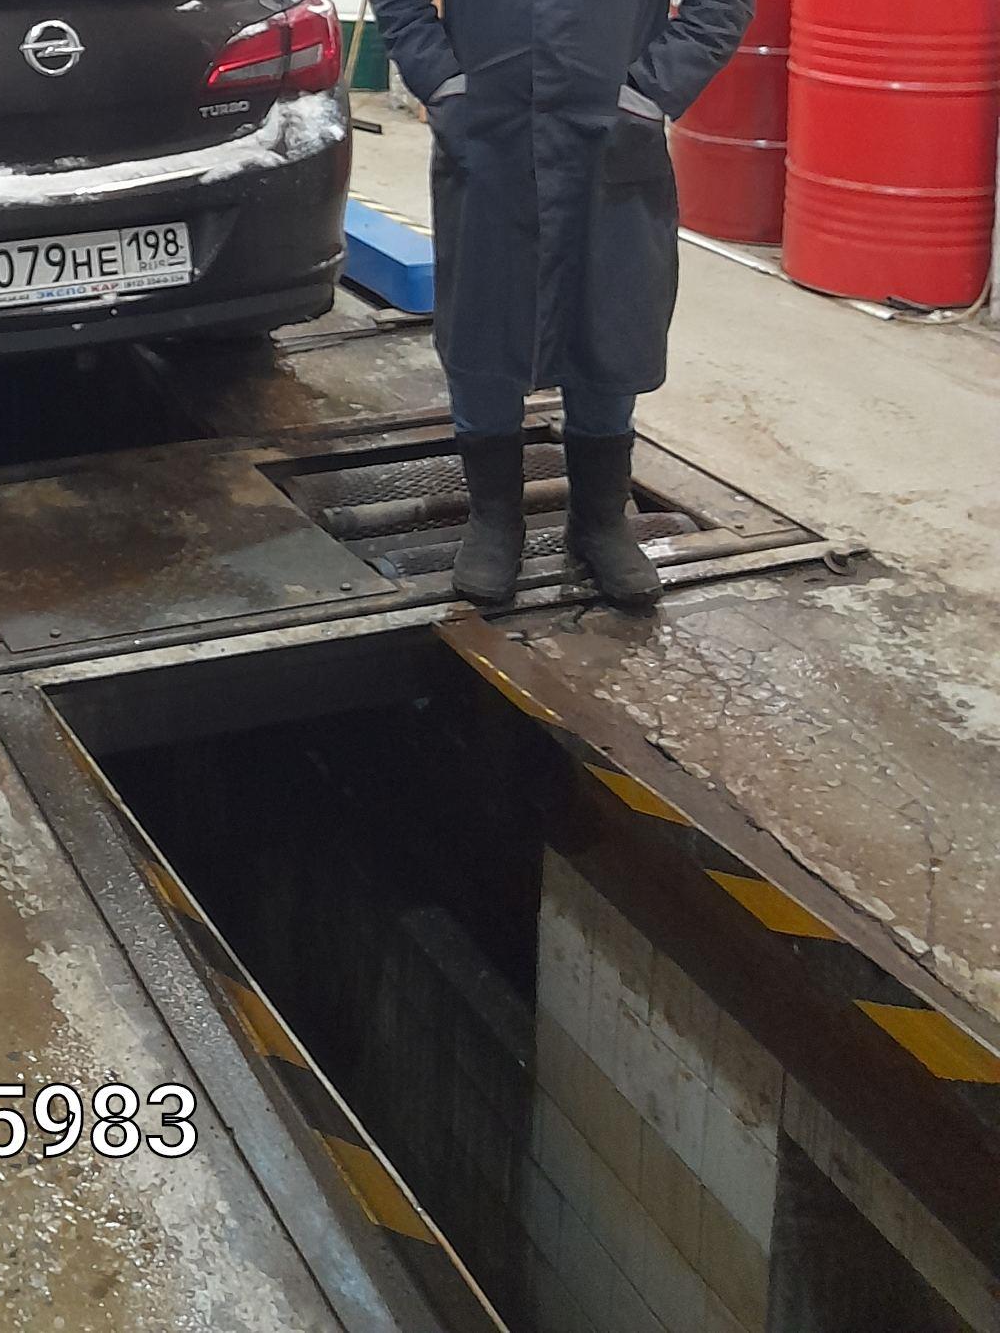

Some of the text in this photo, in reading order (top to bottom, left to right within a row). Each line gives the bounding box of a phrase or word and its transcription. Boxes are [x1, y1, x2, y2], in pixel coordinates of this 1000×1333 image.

[199, 100, 250, 118] TURBO
[126, 227, 180, 261] 198
[139, 259, 166, 271] RUS
[35, 285, 87, 300] ЭКСПО
